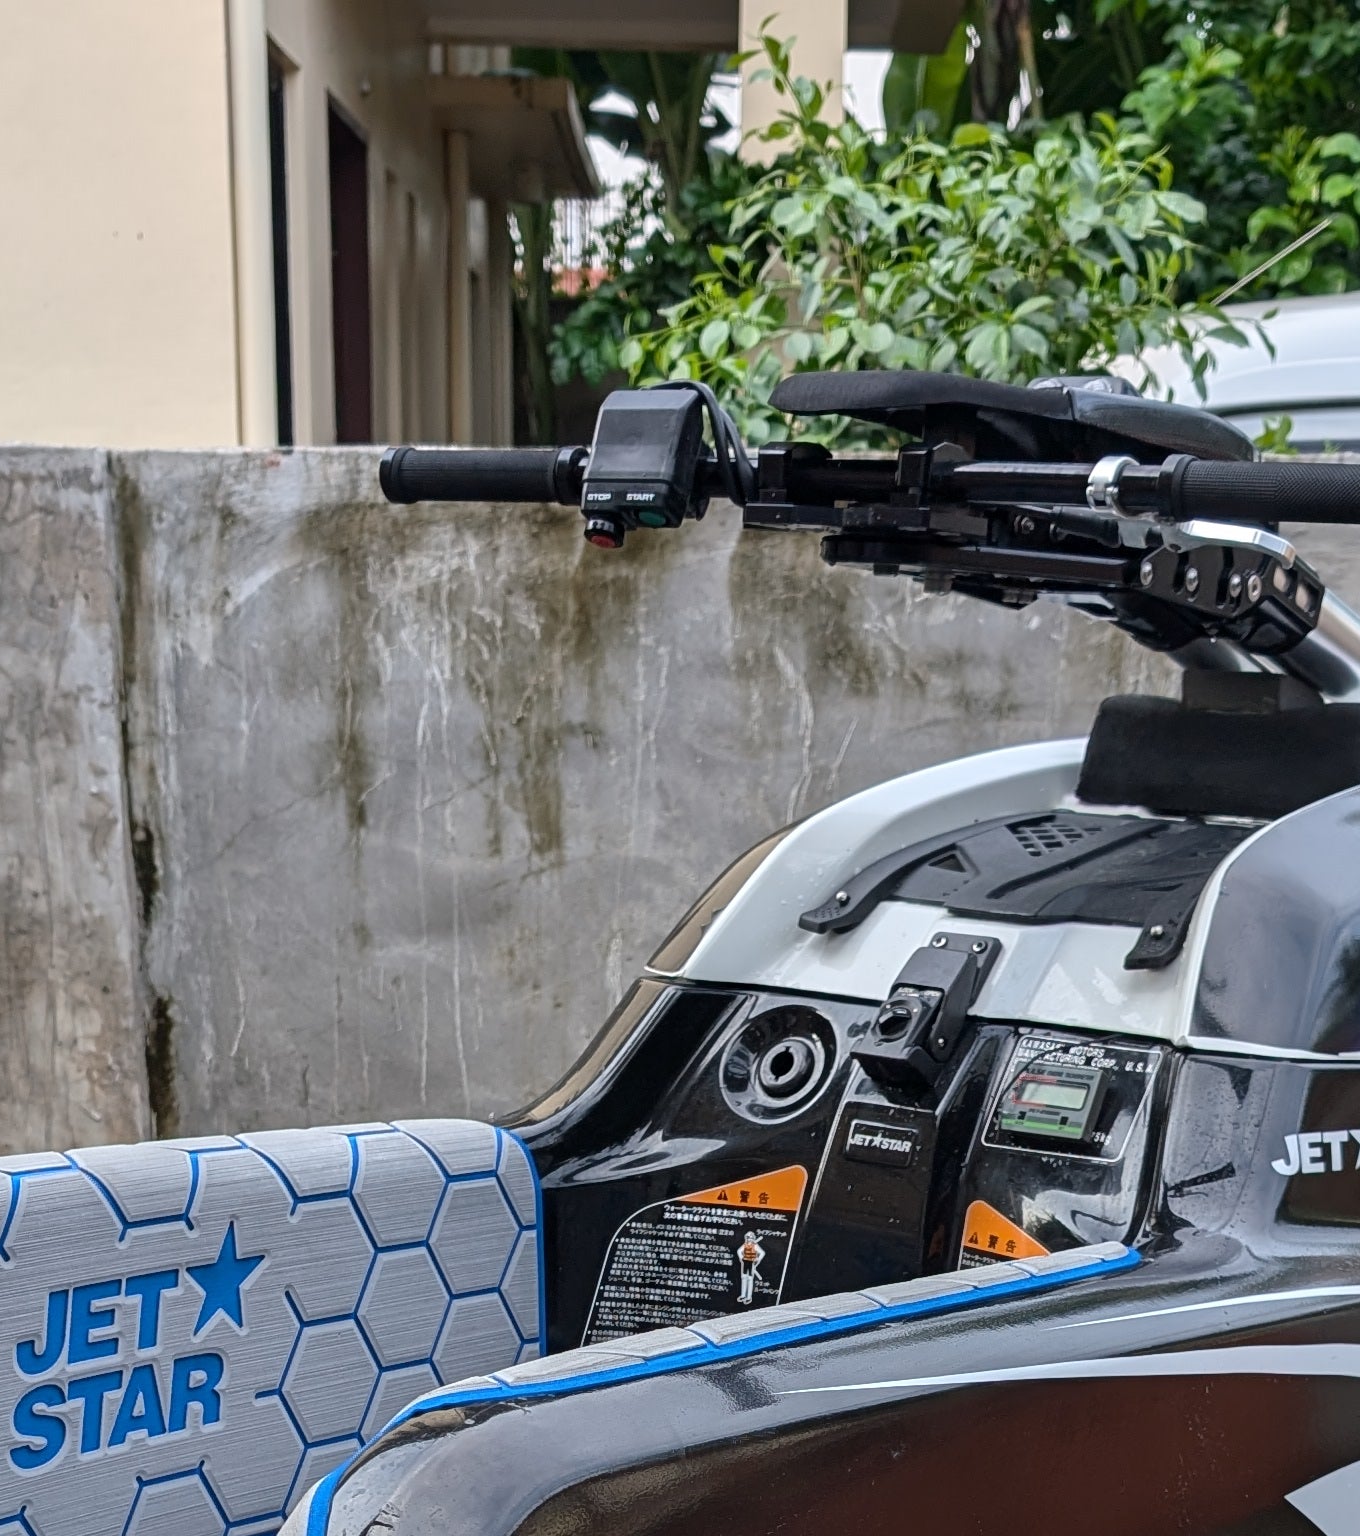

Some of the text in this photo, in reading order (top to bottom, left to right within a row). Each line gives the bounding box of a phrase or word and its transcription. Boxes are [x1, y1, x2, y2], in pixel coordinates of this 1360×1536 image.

[586, 492, 612, 501] STOP
[625, 493, 656, 501] START
[1269, 1132, 1349, 1176] JET
[16, 1268, 180, 1376] JET
[9, 1352, 225, 1471] STAR
